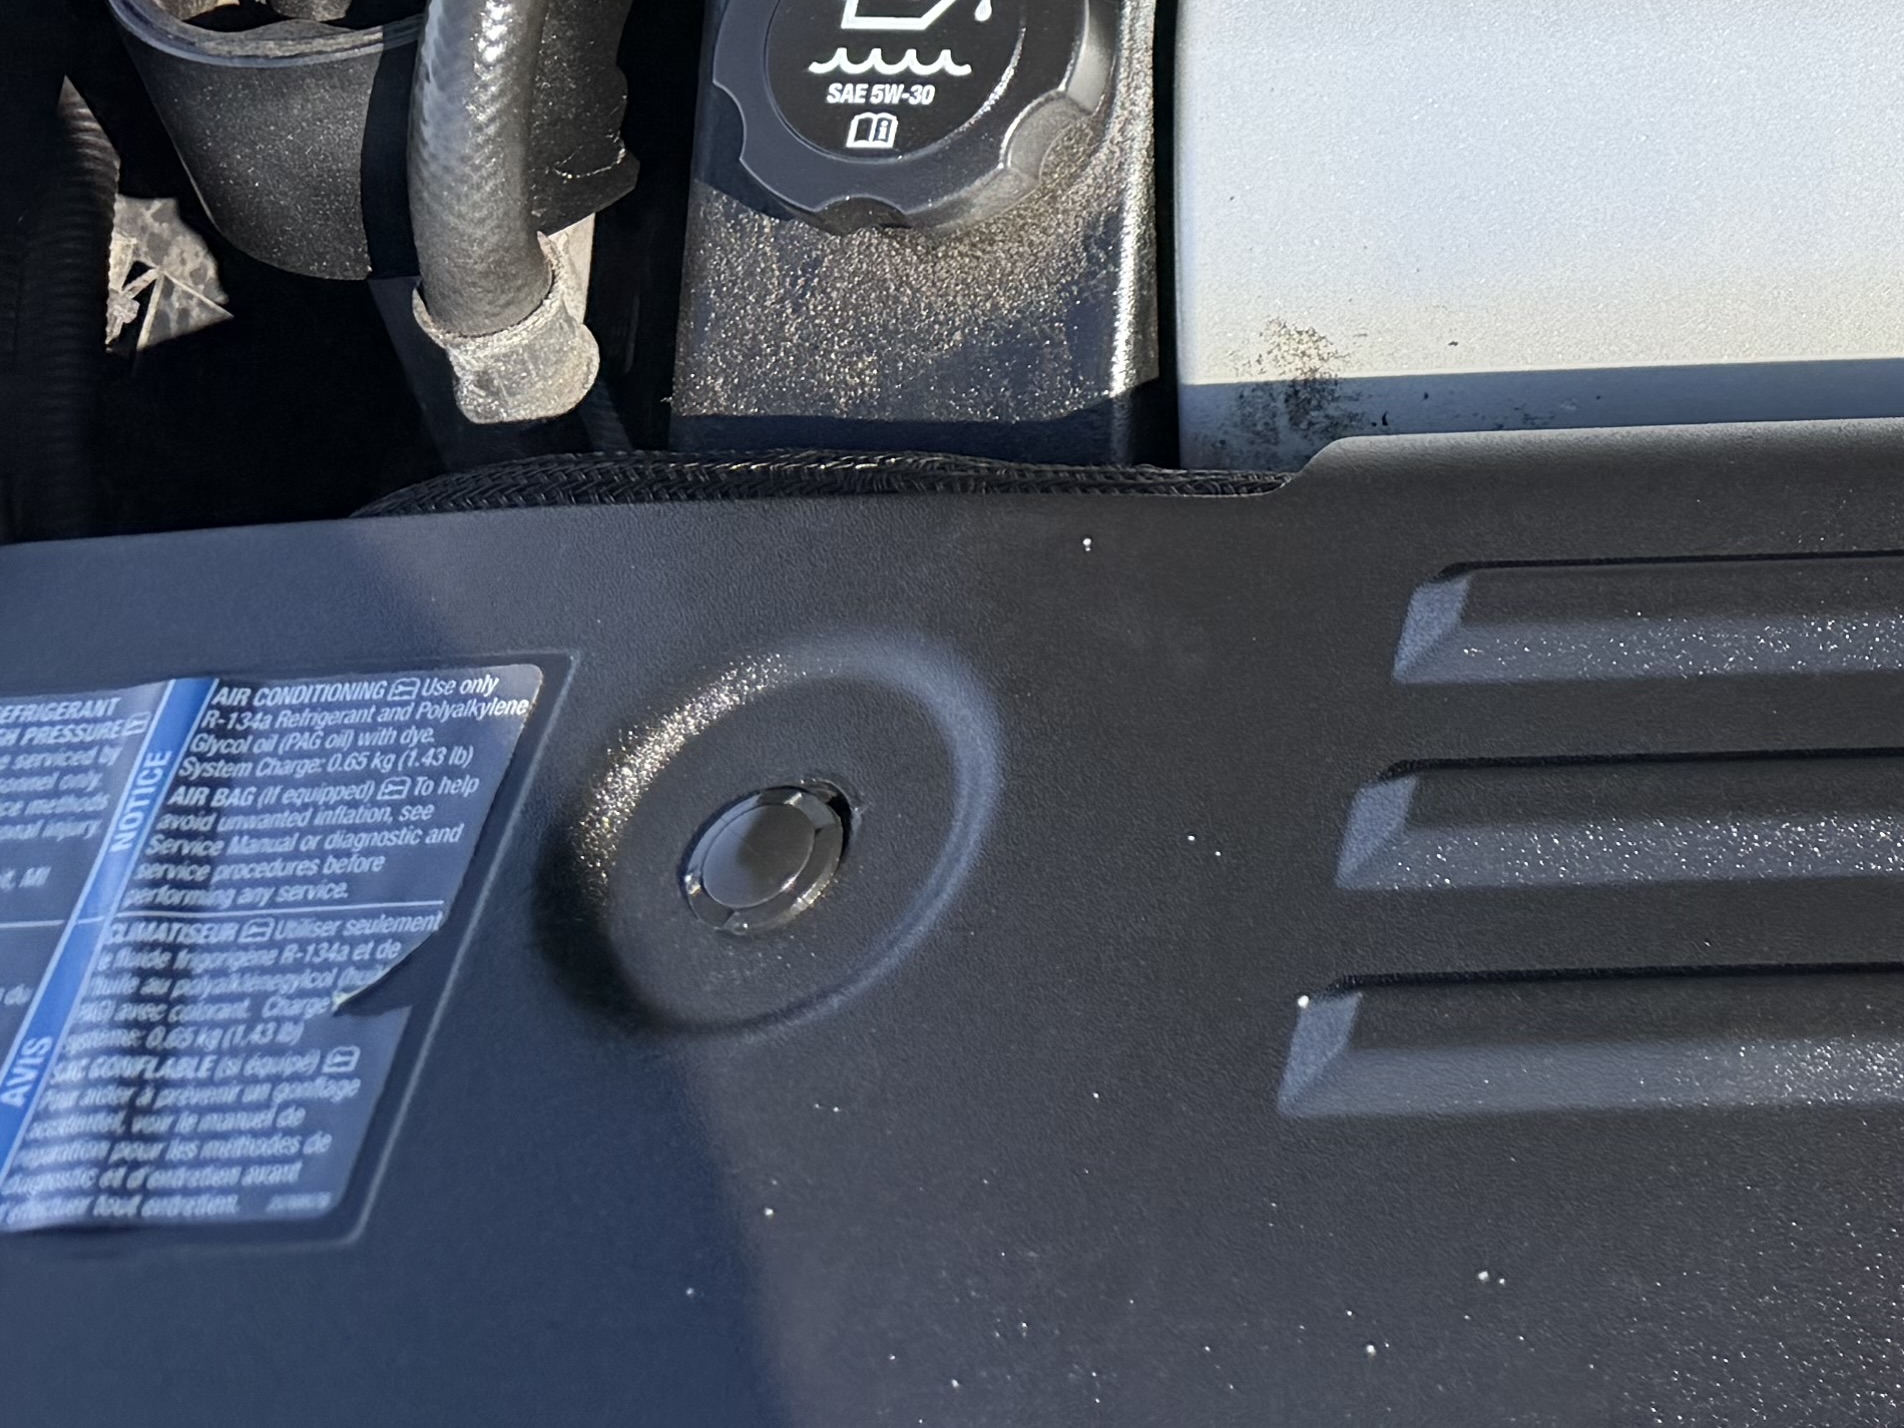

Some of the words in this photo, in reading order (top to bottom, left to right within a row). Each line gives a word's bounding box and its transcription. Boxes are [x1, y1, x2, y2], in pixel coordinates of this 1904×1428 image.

[826, 82, 869, 104] SAE
[869, 83, 936, 105] 5W-30
[212, 687, 252, 706] AIR
[252, 680, 388, 707] CONDITIONING
[421, 677, 456, 697] Use
[459, 674, 500, 697] only
[201, 709, 271, 731] R-134a
[274, 705, 376, 730] Refrigerant
[376, 703, 415, 723] and
[415, 697, 530, 723] Polyalkylene
[19, 719, 125, 746] PRESSURE
[190, 733, 253, 757] Glycol
[252, 734, 280, 755] oil
[278, 729, 323, 756] (PAG
[324, 728, 354, 751] oil)
[357, 727, 397, 746] with
[178, 756, 252, 781] System
[255, 756, 326, 778] Charge:
[327, 751, 369, 772] 0.65
[370, 751, 397, 773] kg
[397, 746, 447, 771] (1.43
[449, 745, 475, 769] lb)
[108, 750, 172, 853] NOTICE
[168, 786, 210, 807] AIR
[210, 786, 257, 808] BAG
[281, 780, 376, 807] equipped)
[414, 776, 436, 796] To
[437, 774, 480, 797] help
[156, 808, 217, 832] avoid
[216, 806, 313, 832] unwanted
[399, 803, 435, 822] see
[145, 833, 225, 857] Service
[225, 831, 299, 856] Manual
[299, 834, 322, 852] or
[322, 825, 424, 852] diagnostic
[424, 823, 465, 845] and
[133, 861, 212, 882] service
[210, 857, 320, 885] procedures
[322, 854, 386, 876] before
[236, 886, 276, 908] any
[342, 911, 443, 937] seulement
[375, 939, 402, 959] de
[262, 996, 331, 1019] Charge
[0, 1036, 53, 1108] AVIS
